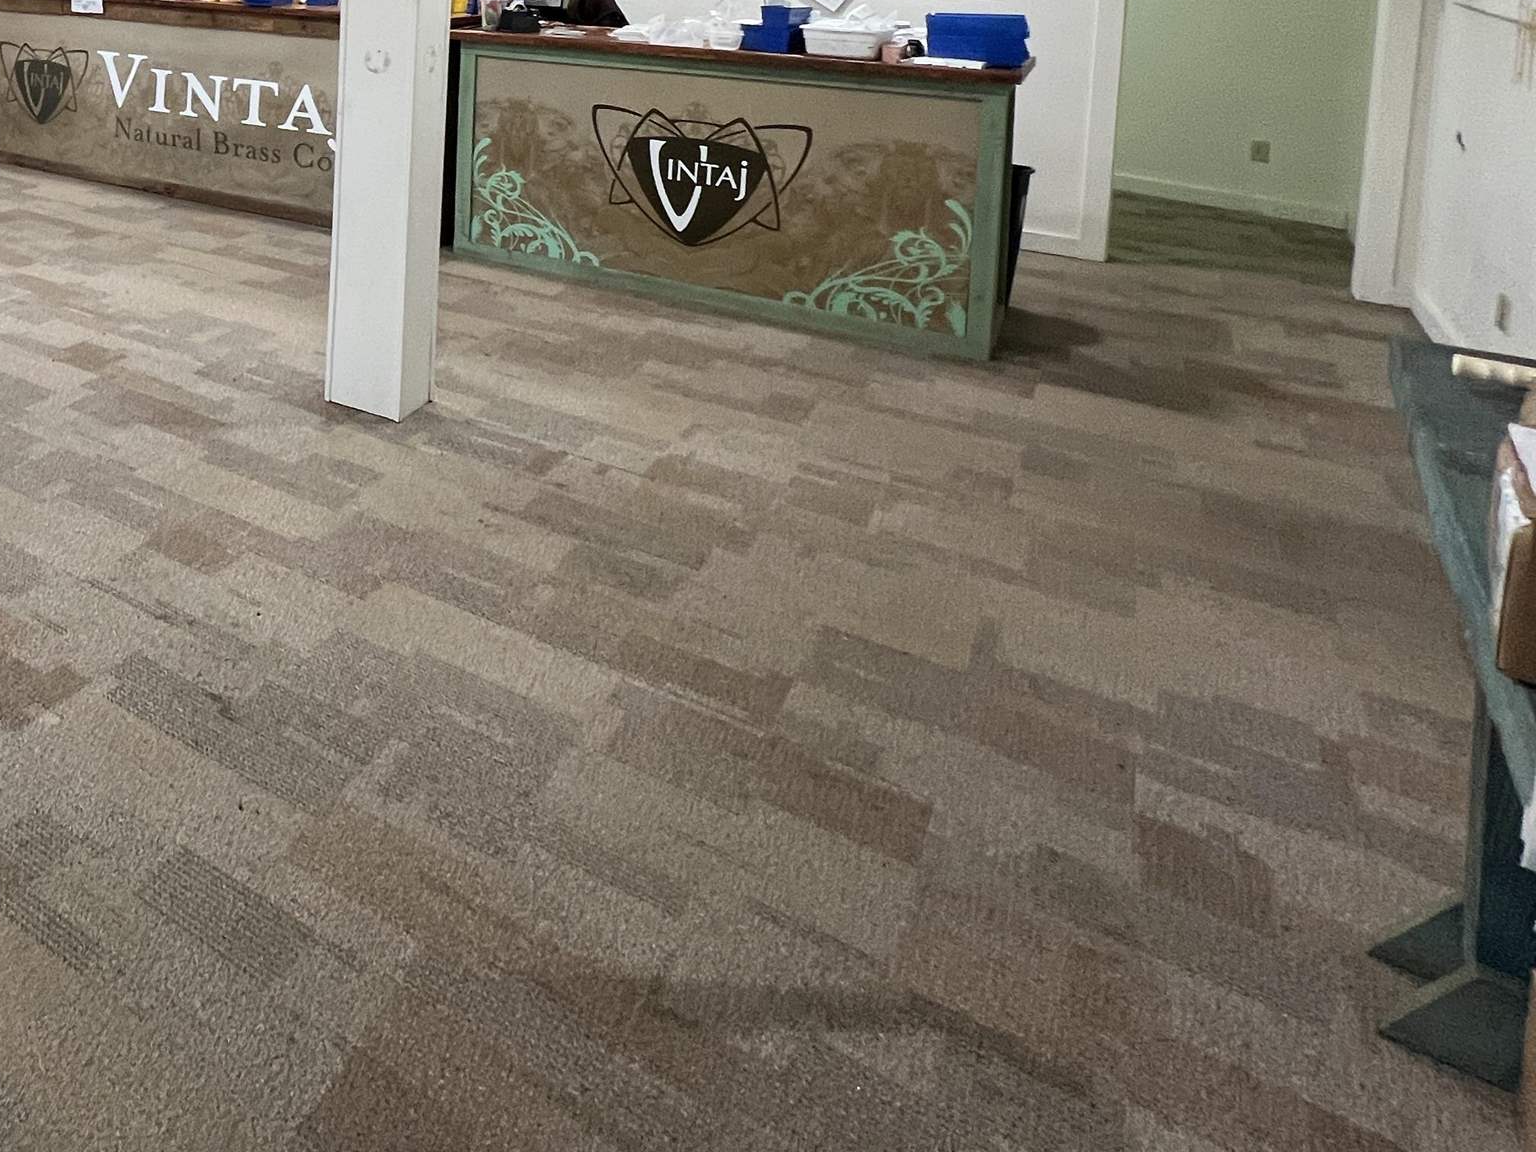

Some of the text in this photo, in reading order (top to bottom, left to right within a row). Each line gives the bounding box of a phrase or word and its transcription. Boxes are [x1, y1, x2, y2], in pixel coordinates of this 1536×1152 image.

[96, 49, 336, 152] VINTA
[114, 116, 202, 153] Natural
[214, 130, 282, 165] Brass
